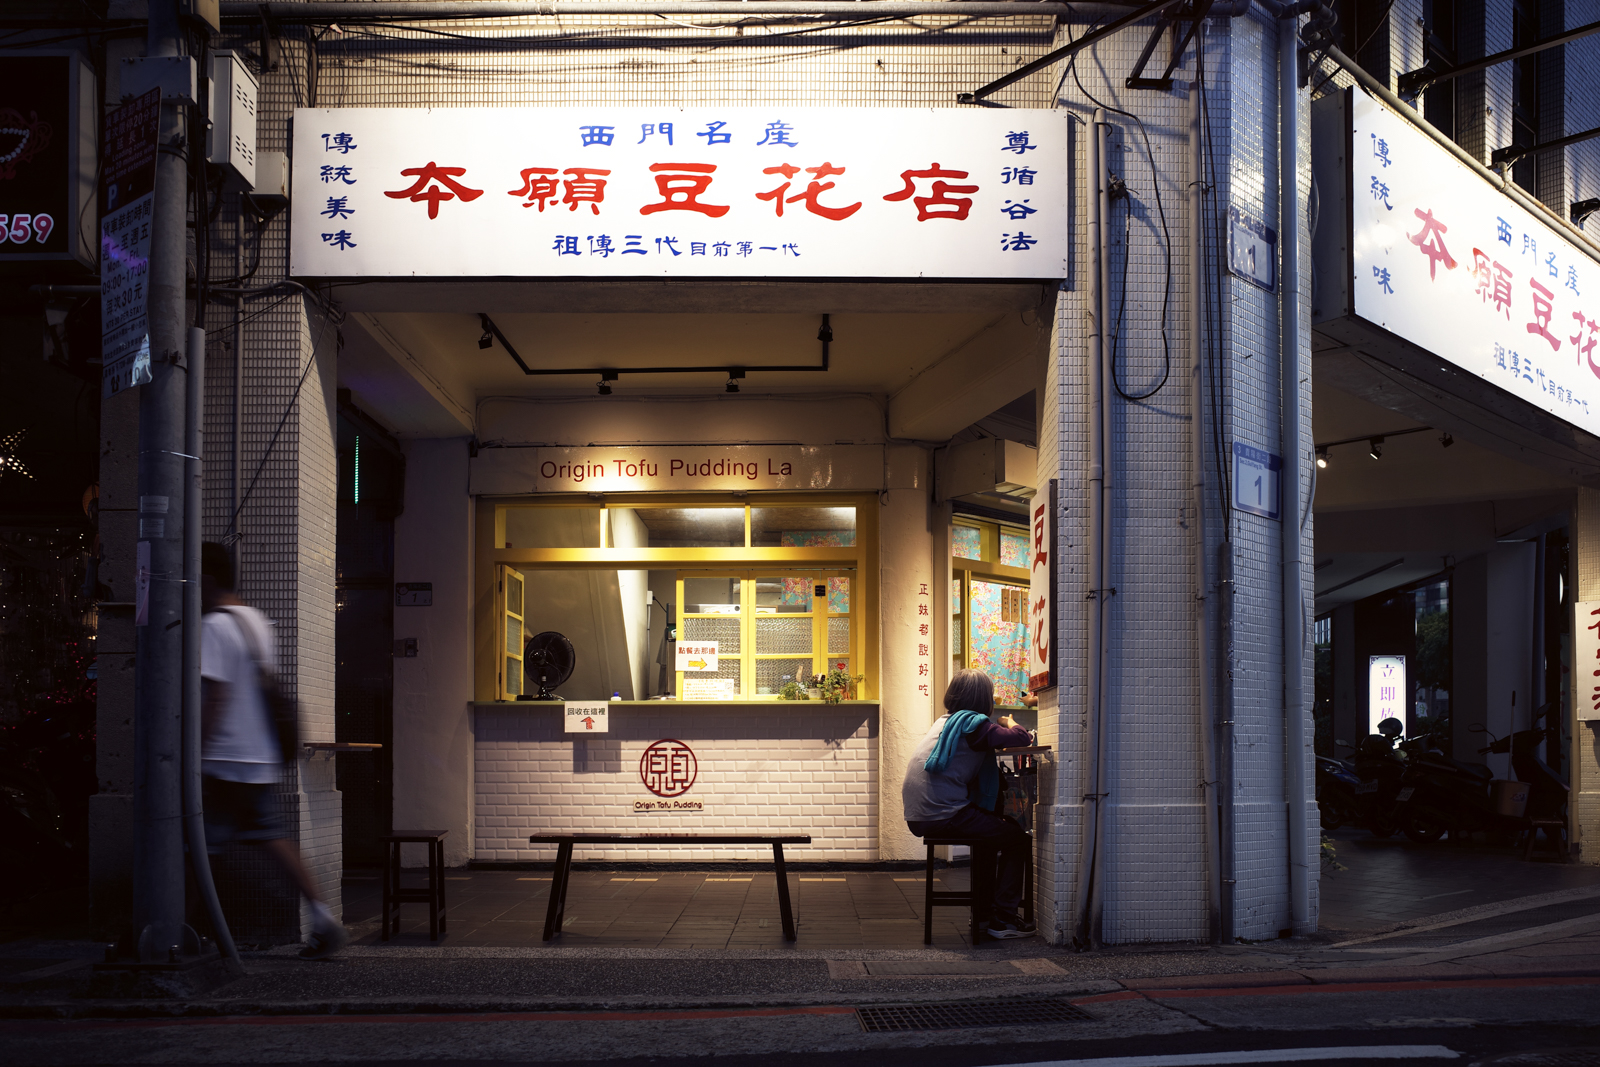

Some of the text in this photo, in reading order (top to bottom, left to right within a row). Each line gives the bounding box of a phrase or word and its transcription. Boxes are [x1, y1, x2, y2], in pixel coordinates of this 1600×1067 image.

[108, 183, 118, 211] P
[320, 132, 358, 251] 傳統美味
[1371, 132, 1394, 295] 傳統味
[102, 260, 147, 296] 09:00-17:00
[130, 304, 143, 317] STAY
[540, 458, 793, 483] Origin Tofu Pudding La
[1254, 475, 1262, 506] 1
[1032, 503, 1049, 665] 豆花
[678, 646, 716, 655] 點餐去那邊
[918, 583, 929, 697] 正妹都說好吃
[567, 707, 606, 716] 回收在這裡
[634, 800, 703, 810] Origin Tofu Pudding
